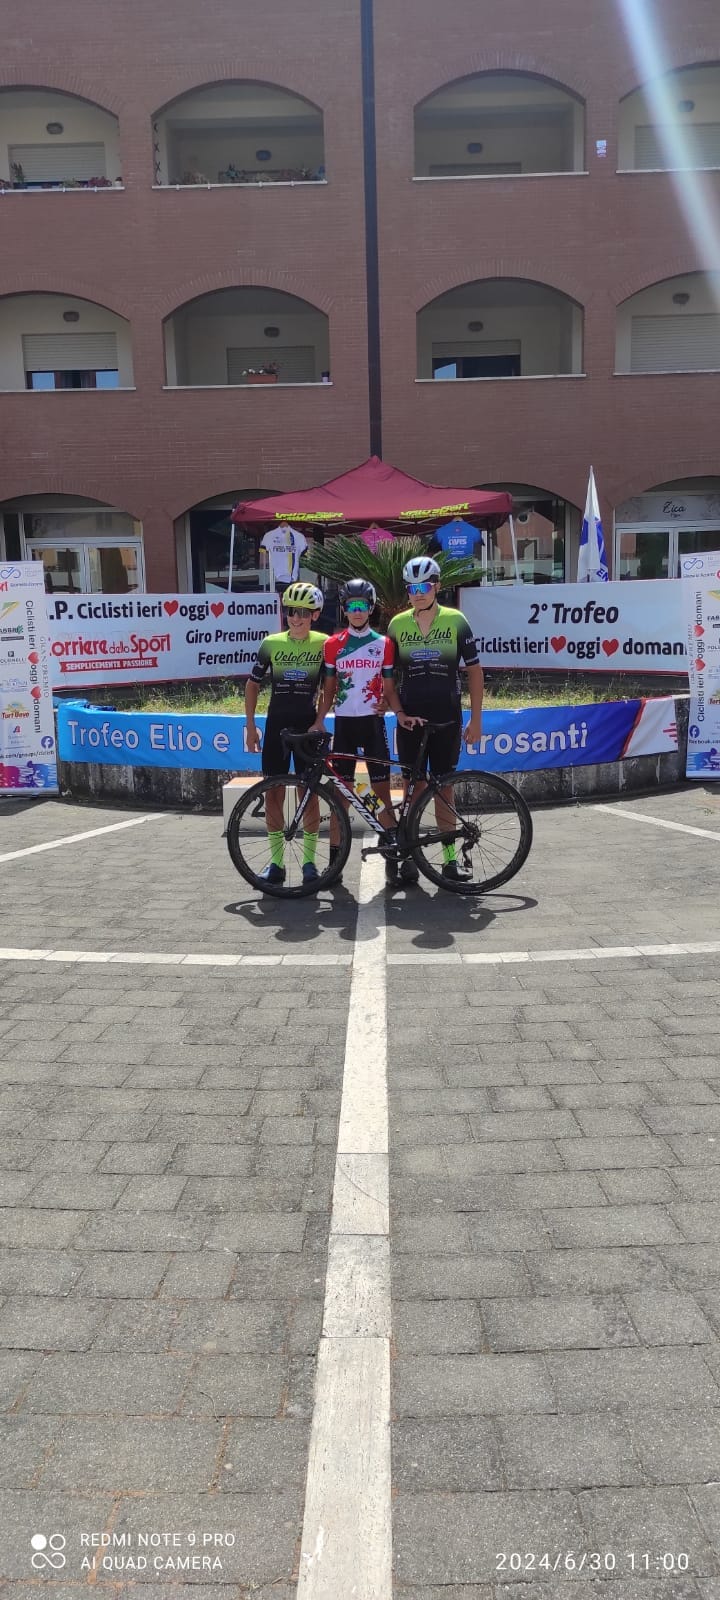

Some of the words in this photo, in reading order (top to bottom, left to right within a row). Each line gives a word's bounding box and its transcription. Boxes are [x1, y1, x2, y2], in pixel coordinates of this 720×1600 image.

[46, 601, 73, 620] .P.
[77, 601, 133, 618] Ciclisti
[137, 601, 162, 618] ieri
[180, 600, 209, 621] oggi
[227, 600, 277, 616] domani
[552, 601, 619, 624] Trofeo
[693, 591, 703, 625] domani
[48, 636, 108, 656] orriere
[186, 629, 211, 644] Giro
[215, 627, 269, 642] Premium
[198, 649, 257, 666] Ferentino
[474, 637, 521, 653] Ciclisti
[524, 637, 548, 653] ieri
[567, 637, 600, 659] oggi
[66, 660, 121, 671] SEMPLICEMENTE
[338, 659, 382, 669] UMBRIA
[33, 699, 42, 733] domani
[67, 720, 140, 750] Trofeo
[150, 723, 203, 752] Elio
[213, 732, 230, 753] e
[251, 793, 266, 817] 2
[328, 775, 387, 833] MERIDA
